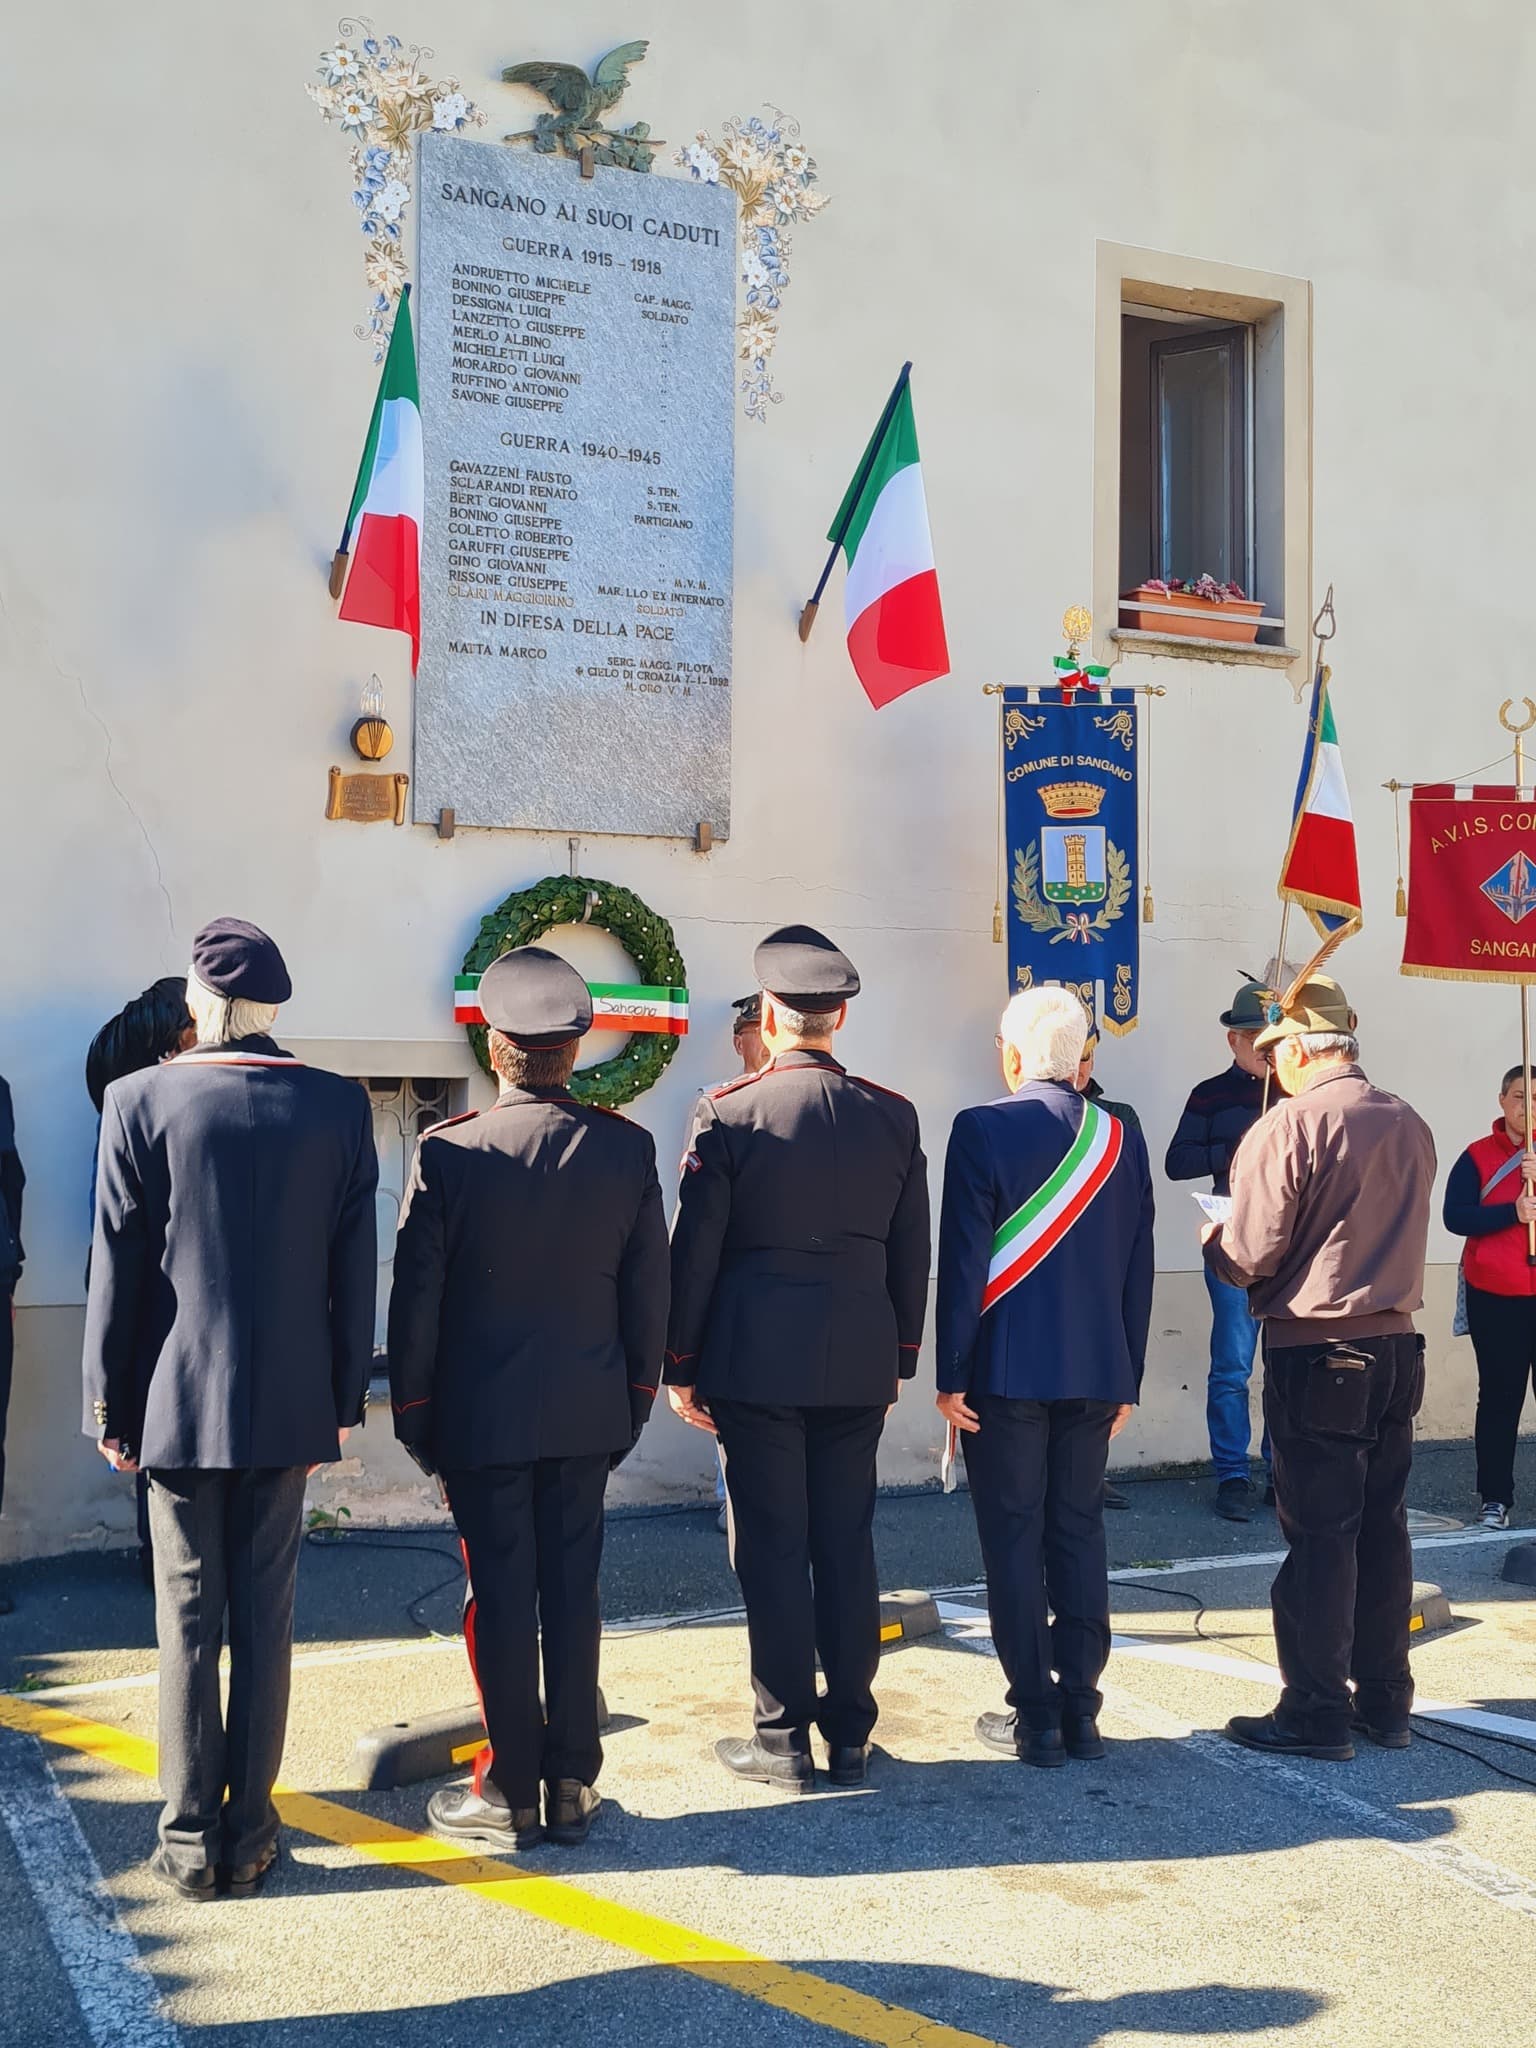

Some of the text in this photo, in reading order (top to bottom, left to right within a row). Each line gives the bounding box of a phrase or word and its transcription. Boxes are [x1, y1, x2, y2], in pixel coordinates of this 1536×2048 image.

[441, 183, 720, 247] SANGANO AI SUOI CADUTI
[502, 237, 573, 261] GUERRA
[581, 250, 613, 267] 1915
[631, 258, 662, 275] 1918
[453, 263, 592, 294] ANDRUETTO MICHELE
[452, 279, 566, 306] BONINO GIUSEPPE
[661, 297, 694, 311] MAGG.
[453, 293, 551, 319] DESSIGNA LUIGI
[641, 310, 689, 325] SOLDATO
[453, 309, 586, 339] LANZETTO GIUSEPPE
[453, 325, 551, 349] MERLO ALBINO
[453, 341, 565, 367] MICHELETTI LUIGI
[452, 356, 581, 385] MORARDO GIOVANNI
[452, 372, 568, 398] RUFFINO ANTONIO
[452, 389, 564, 413] SAVONE GIUSEPPE
[500, 432, 570, 454] GUERRA
[450, 460, 572, 485] GAVAZZENI FAUSTO
[450, 476, 578, 500] SCLARANDI RENATO
[450, 492, 547, 513] BERT GIOVANNI
[450, 507, 562, 530] BONINO GIUSEPPE
[634, 514, 693, 530] PARTIGIANO
[448, 523, 573, 546] COLETTO ROBERTO
[449, 540, 570, 561] GARUFFI GIUSEPPE
[449, 555, 546, 574] GINO GIOVANNI
[449, 570, 568, 592] RISSONE GIUSEPPE
[637, 603, 684, 617] SOLDATO
[653, 591, 667, 601] EX
[671, 593, 725, 607] INTERNATO
[481, 611, 674, 641] IN DIFESA DELLA PACE
[449, 641, 547, 660] MATTA MARCO
[587, 667, 619, 678] CIELO
[623, 670, 633, 679] DI
[637, 671, 681, 684] CROAZIA
[677, 662, 713, 674] PILOTA
[639, 683, 662, 694] ORO
[1007, 755, 1133, 782] COMUNE DI SANGANO
[1500, 813, 1536, 831] CO
